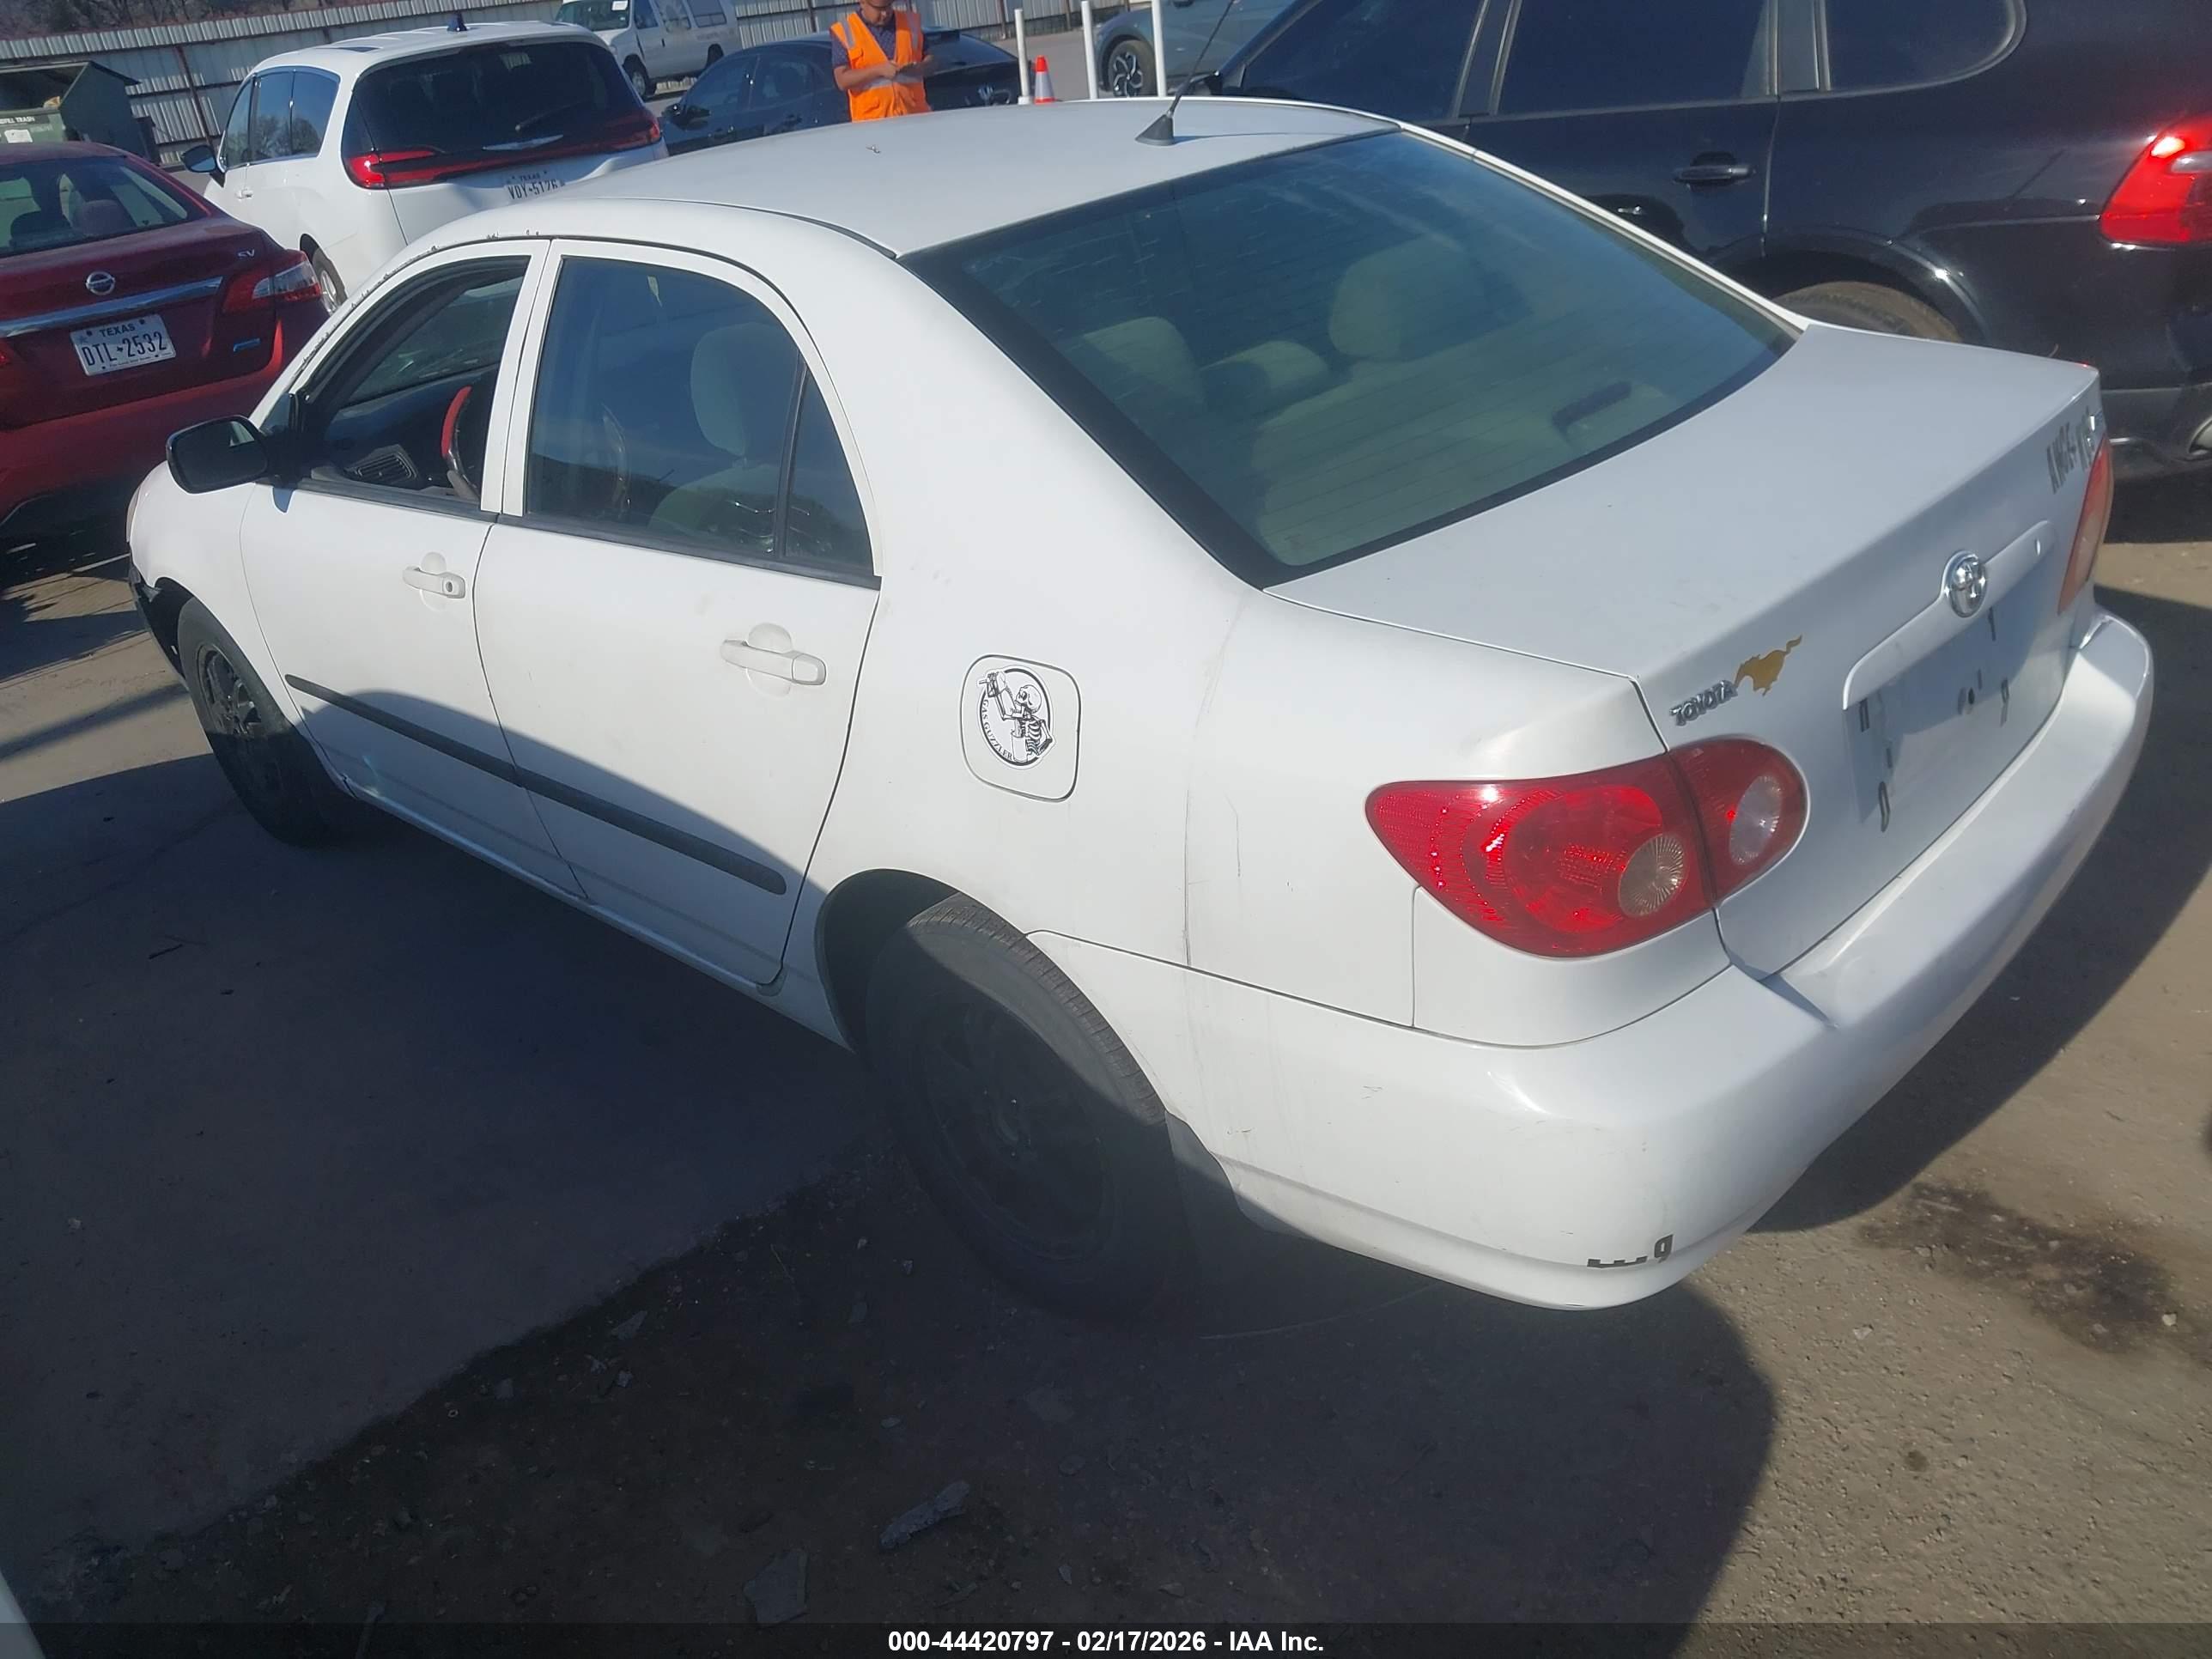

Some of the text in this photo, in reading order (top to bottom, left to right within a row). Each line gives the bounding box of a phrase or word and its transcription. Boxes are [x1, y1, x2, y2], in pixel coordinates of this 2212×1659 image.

[99, 323, 136, 337] TEXAS
[1669, 680, 1738, 726] TOYOTA
[984, 722, 1013, 761] GUZZLER
